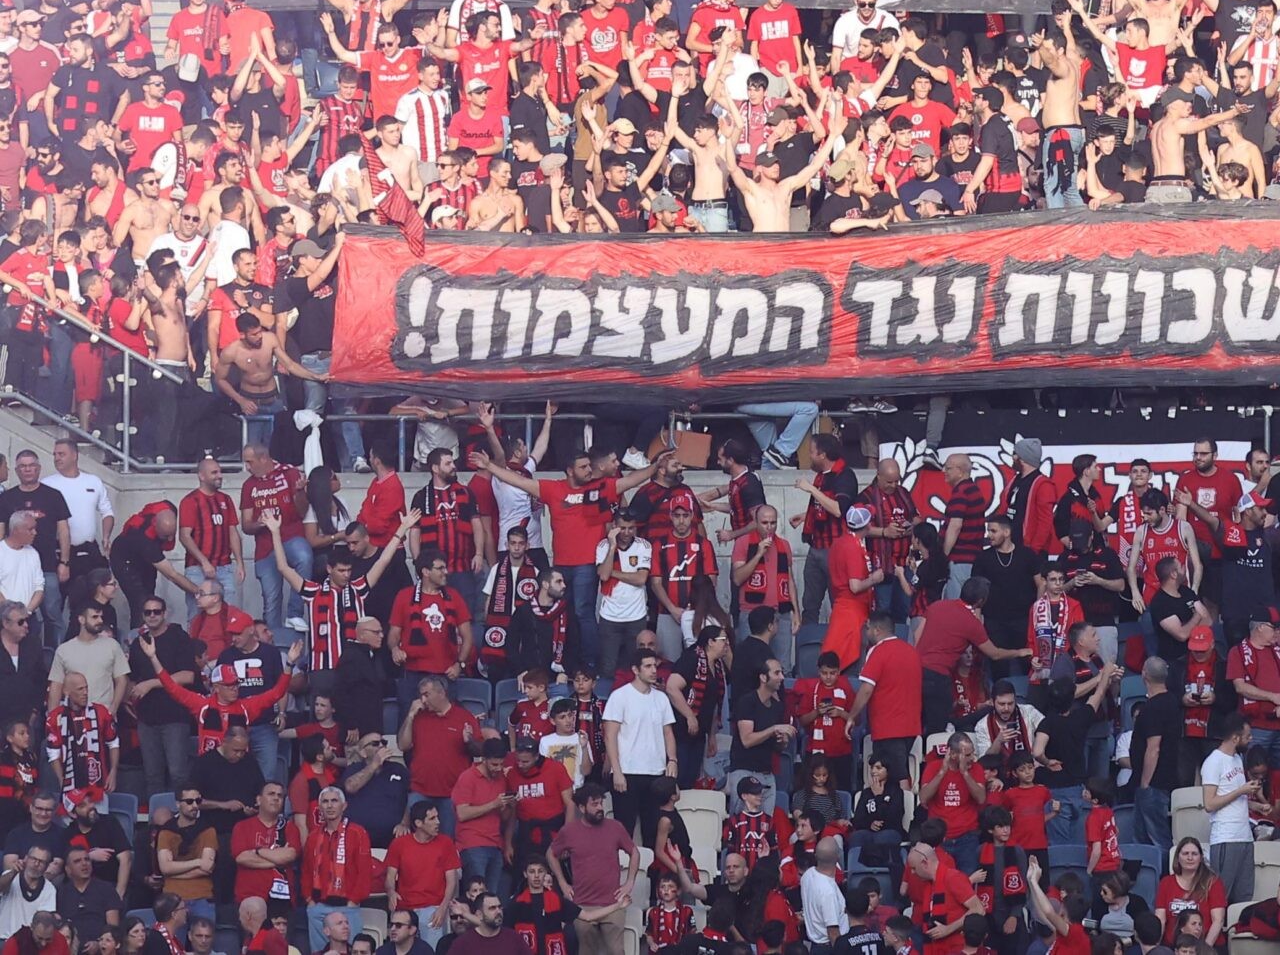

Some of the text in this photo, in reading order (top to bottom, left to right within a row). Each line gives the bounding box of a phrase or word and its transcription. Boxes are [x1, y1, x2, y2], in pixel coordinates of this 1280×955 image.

[378, 74, 411, 82] SHARP
[911, 130, 931, 138] אהב
[847, 274, 977, 347] נגד
[402, 277, 825, 365] המעצמות!
[212, 514, 223, 526] 10
[1147, 538, 1155, 549] 9
[866, 800, 877, 813] 18
